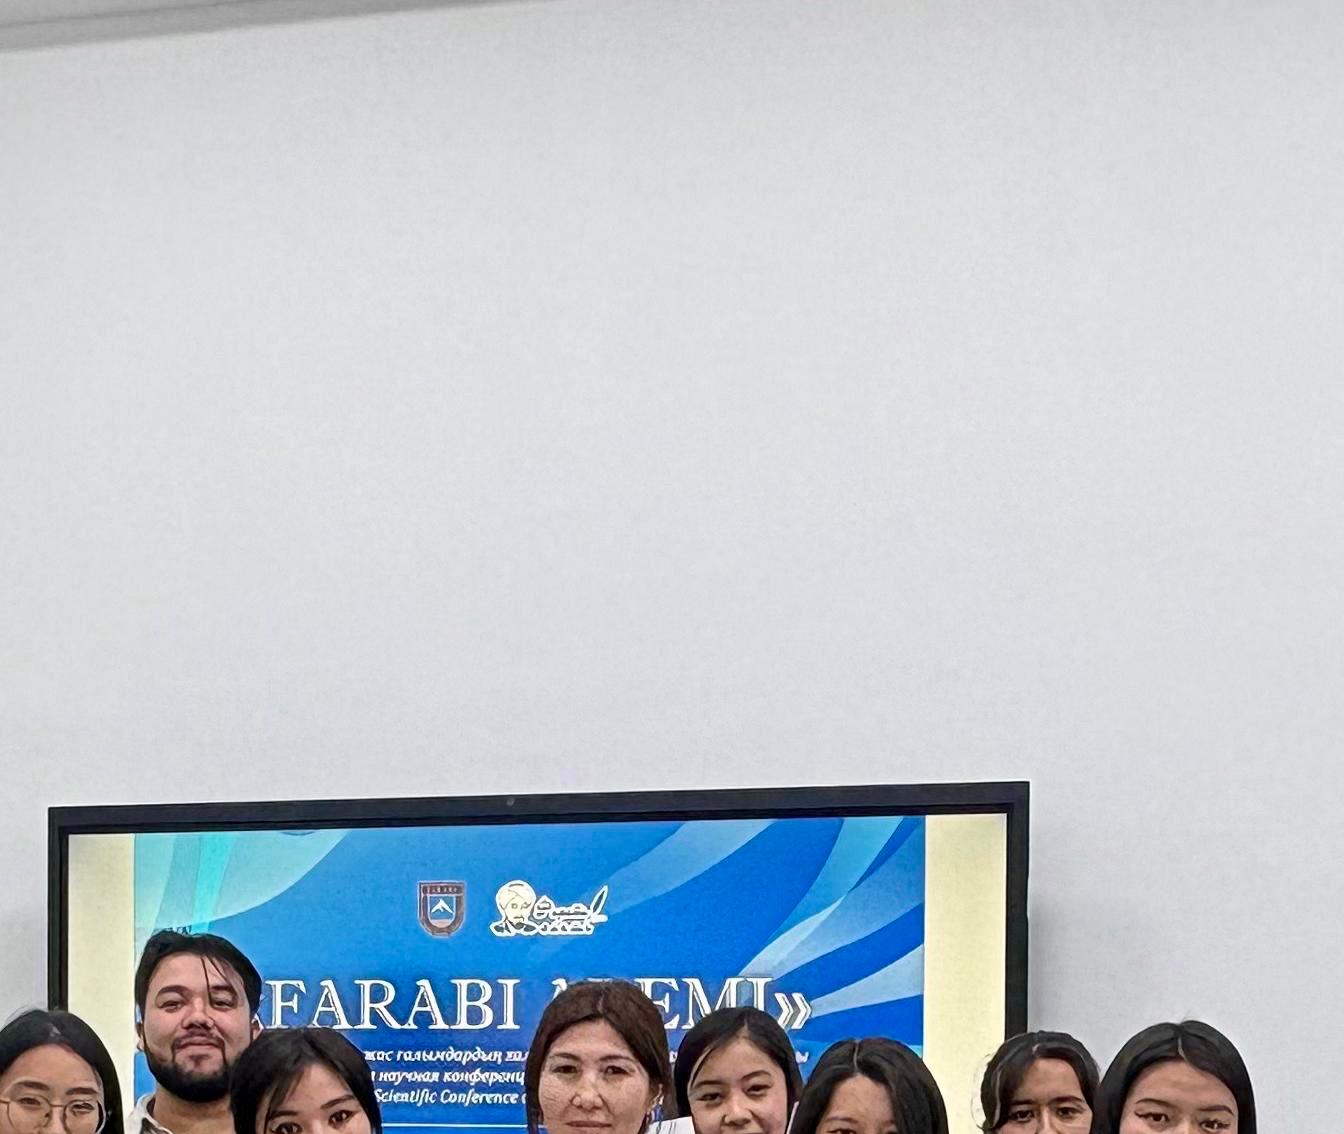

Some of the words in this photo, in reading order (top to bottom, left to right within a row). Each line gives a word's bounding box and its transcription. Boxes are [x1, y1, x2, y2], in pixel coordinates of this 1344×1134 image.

[260, 978, 521, 1030] FARABI
[551, 977, 813, 1030] EMI»
[378, 1070, 439, 1086] научная
[443, 1068, 525, 1087] конференц
[373, 1088, 438, 1107] Scientific
[440, 1088, 519, 1107] Conference
